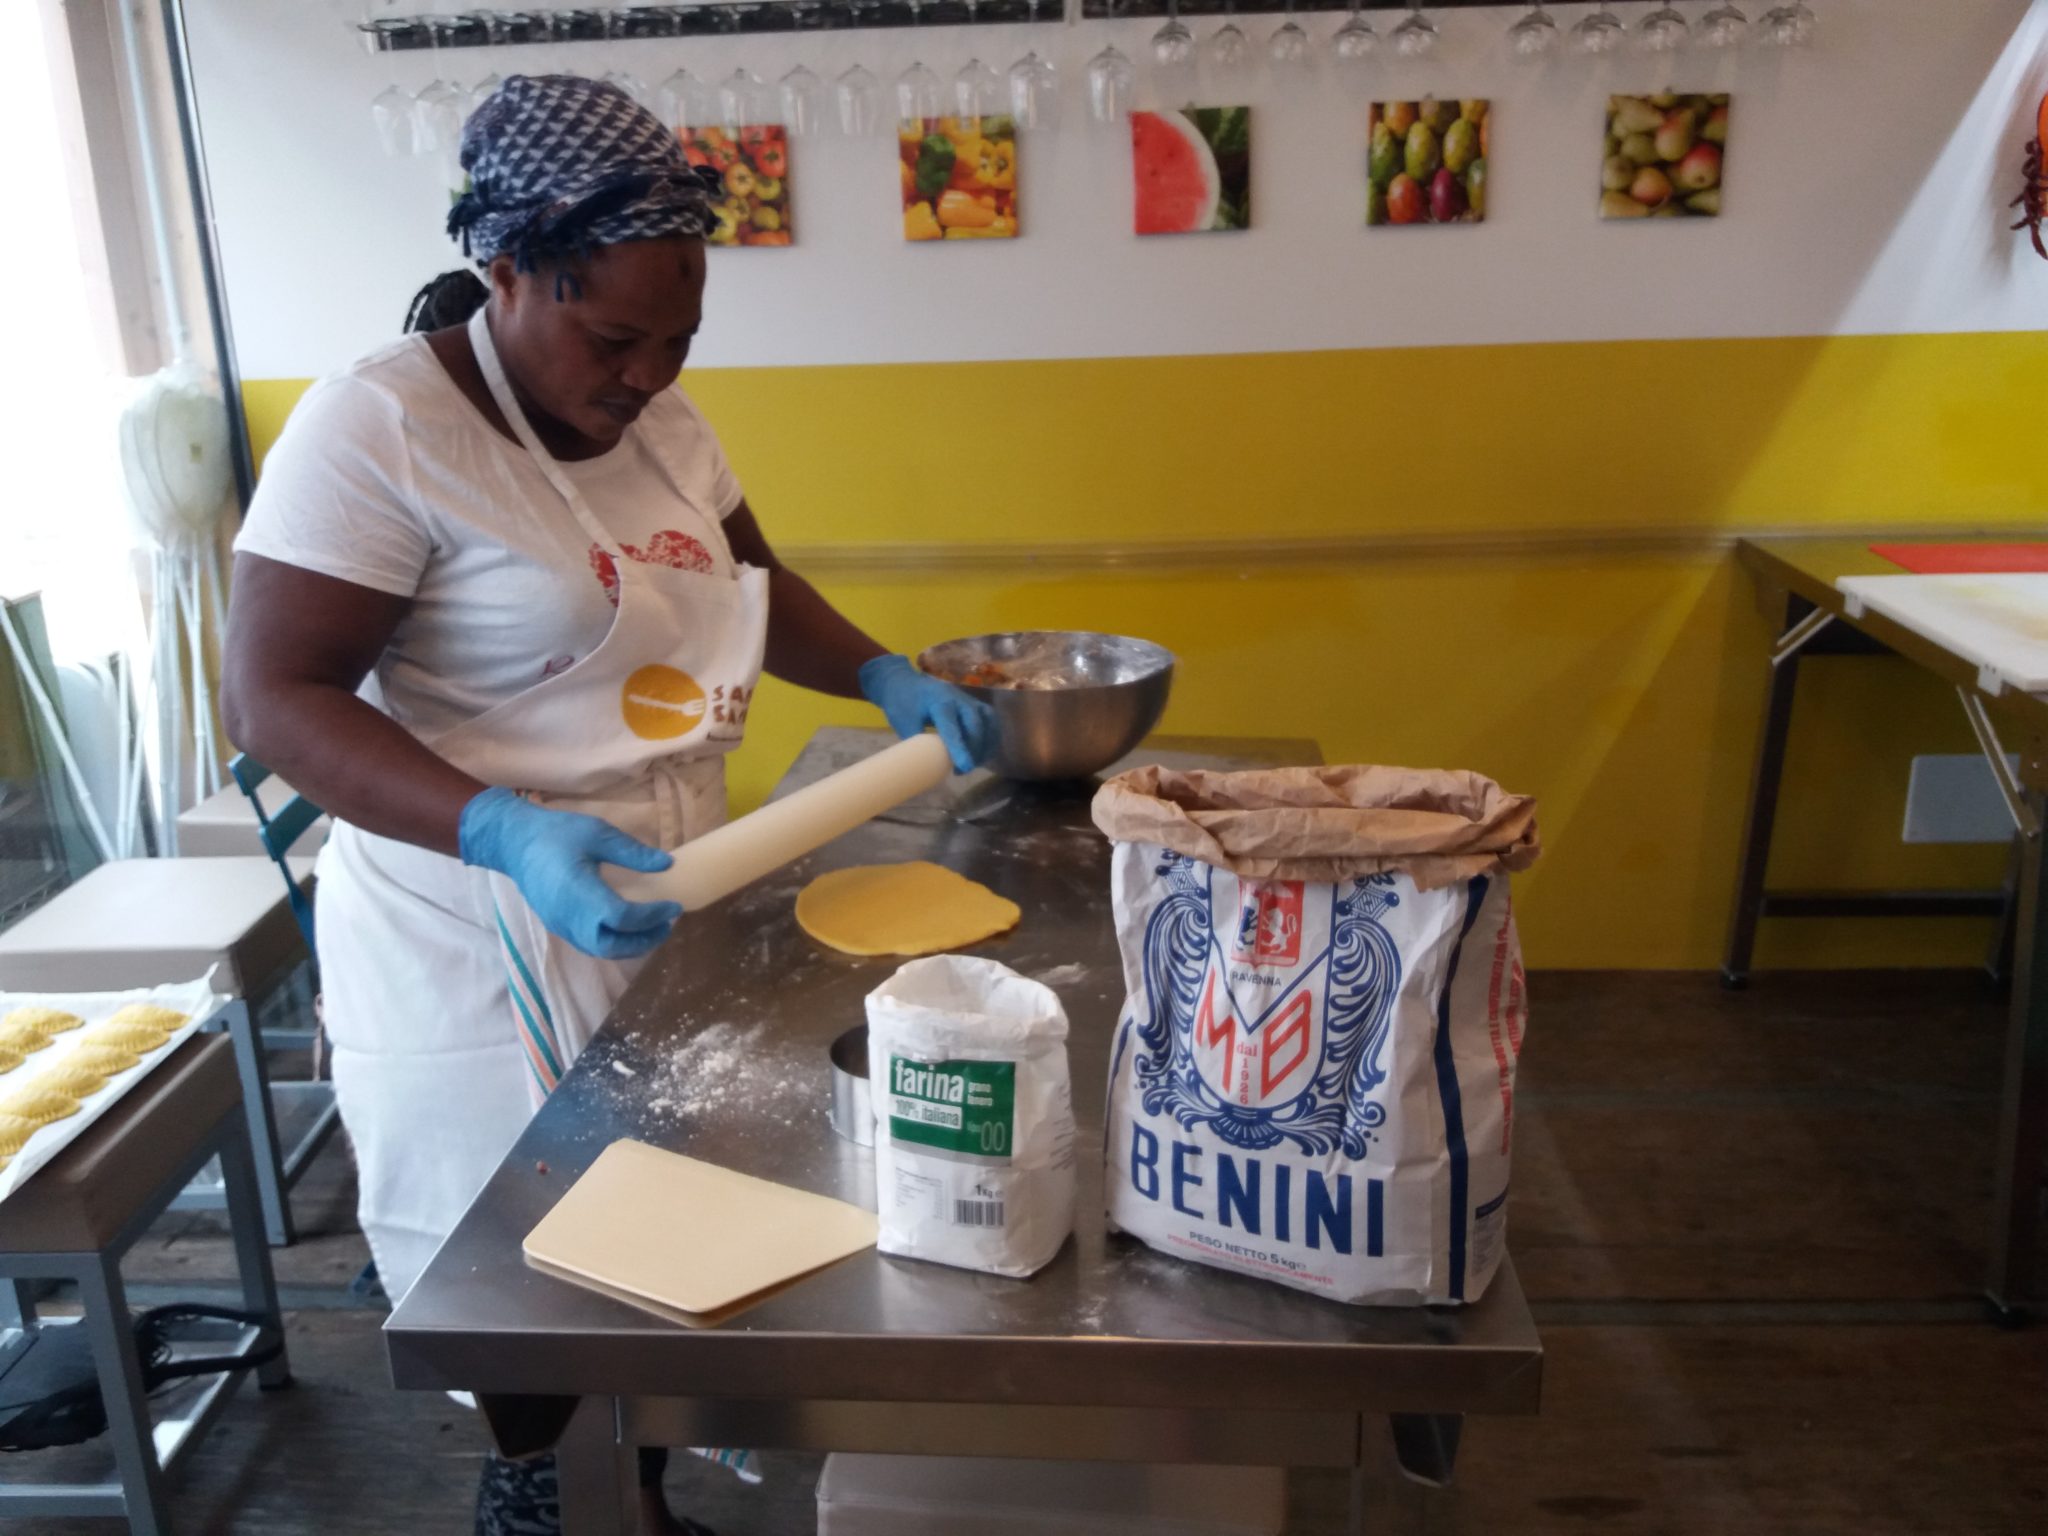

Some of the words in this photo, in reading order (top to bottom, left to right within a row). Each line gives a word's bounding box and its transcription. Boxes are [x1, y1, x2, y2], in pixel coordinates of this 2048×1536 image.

[1231, 971, 1281, 986] RAVENNA
[1236, 1042, 1258, 1057] dal
[895, 1060, 964, 1103] farina
[896, 1100, 920, 1119] 100%
[921, 1104, 959, 1126] italiana
[981, 1121, 1005, 1152] 00
[1131, 1120, 1383, 1257] BENINI
[1190, 1232, 1222, 1248] PESO
[1225, 1243, 1267, 1261] NETTO
[1270, 1253, 1279, 1264] 5
